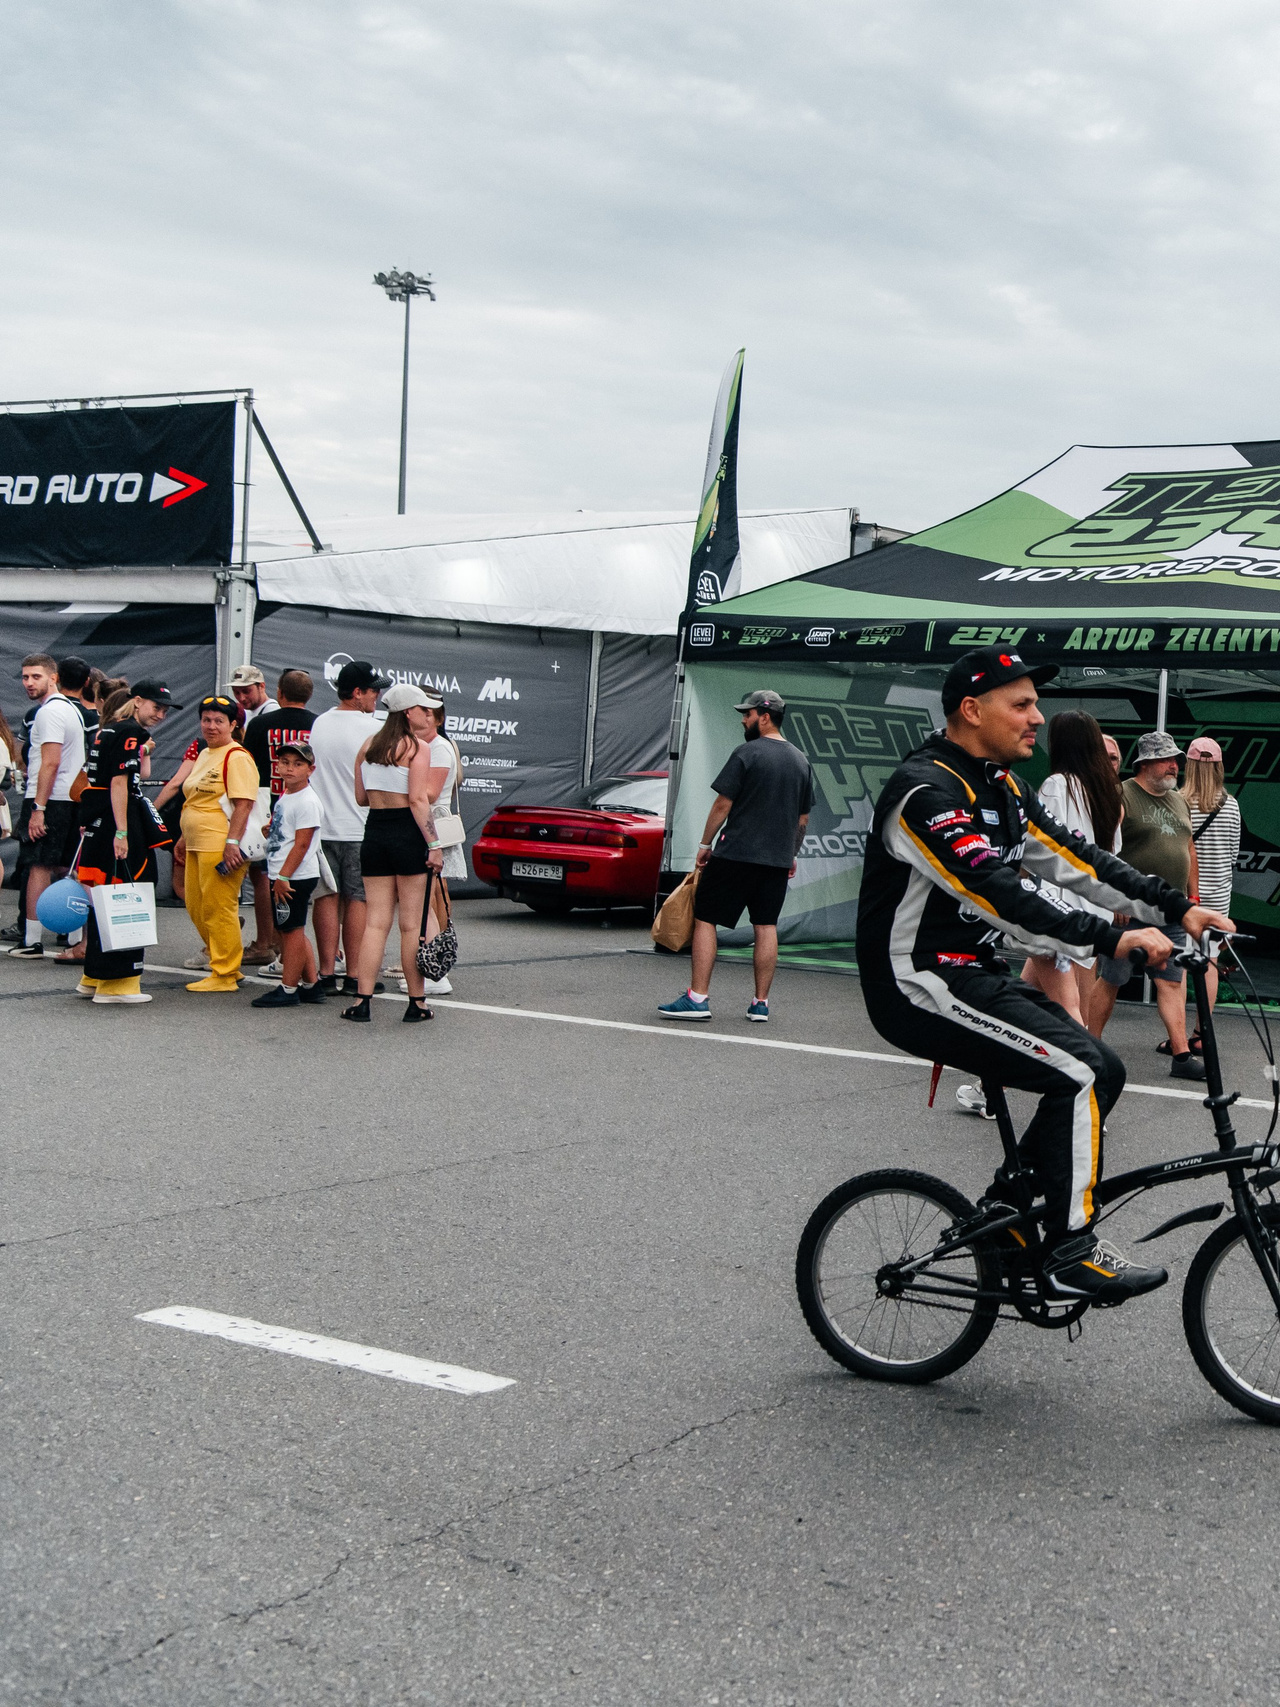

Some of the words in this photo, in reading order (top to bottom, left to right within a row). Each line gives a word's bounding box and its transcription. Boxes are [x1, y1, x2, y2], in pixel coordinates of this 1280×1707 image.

[45, 473, 143, 504] AUTO
[693, 627, 712, 637] LEVEL
[743, 626, 788, 637] TEAM
[861, 625, 906, 636] TEAM
[738, 636, 770, 645] 234
[856, 636, 891, 645] 234
[949, 627, 1028, 646] 234
[1063, 627, 1154, 651] ARTUR
[445, 715, 519, 736] ВИРАЖ
[446, 732, 492, 744] ЕХМАРКЕТЫ
